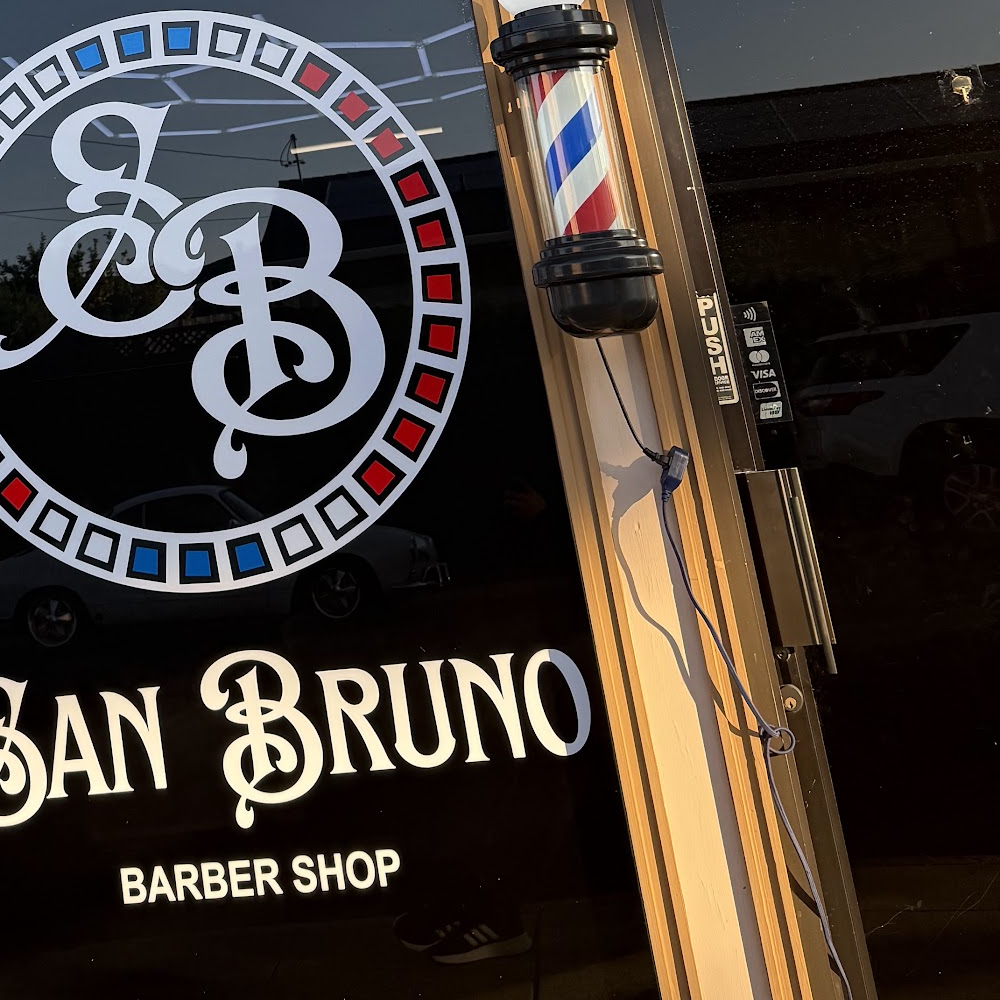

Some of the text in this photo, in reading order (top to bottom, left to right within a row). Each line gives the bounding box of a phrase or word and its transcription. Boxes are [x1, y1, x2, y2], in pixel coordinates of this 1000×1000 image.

[696, 298, 729, 376] PUSH
[750, 368, 777, 379] VISA
[200, 648, 592, 829] BRUNO
[120, 848, 401, 905] BARBER SHOP
